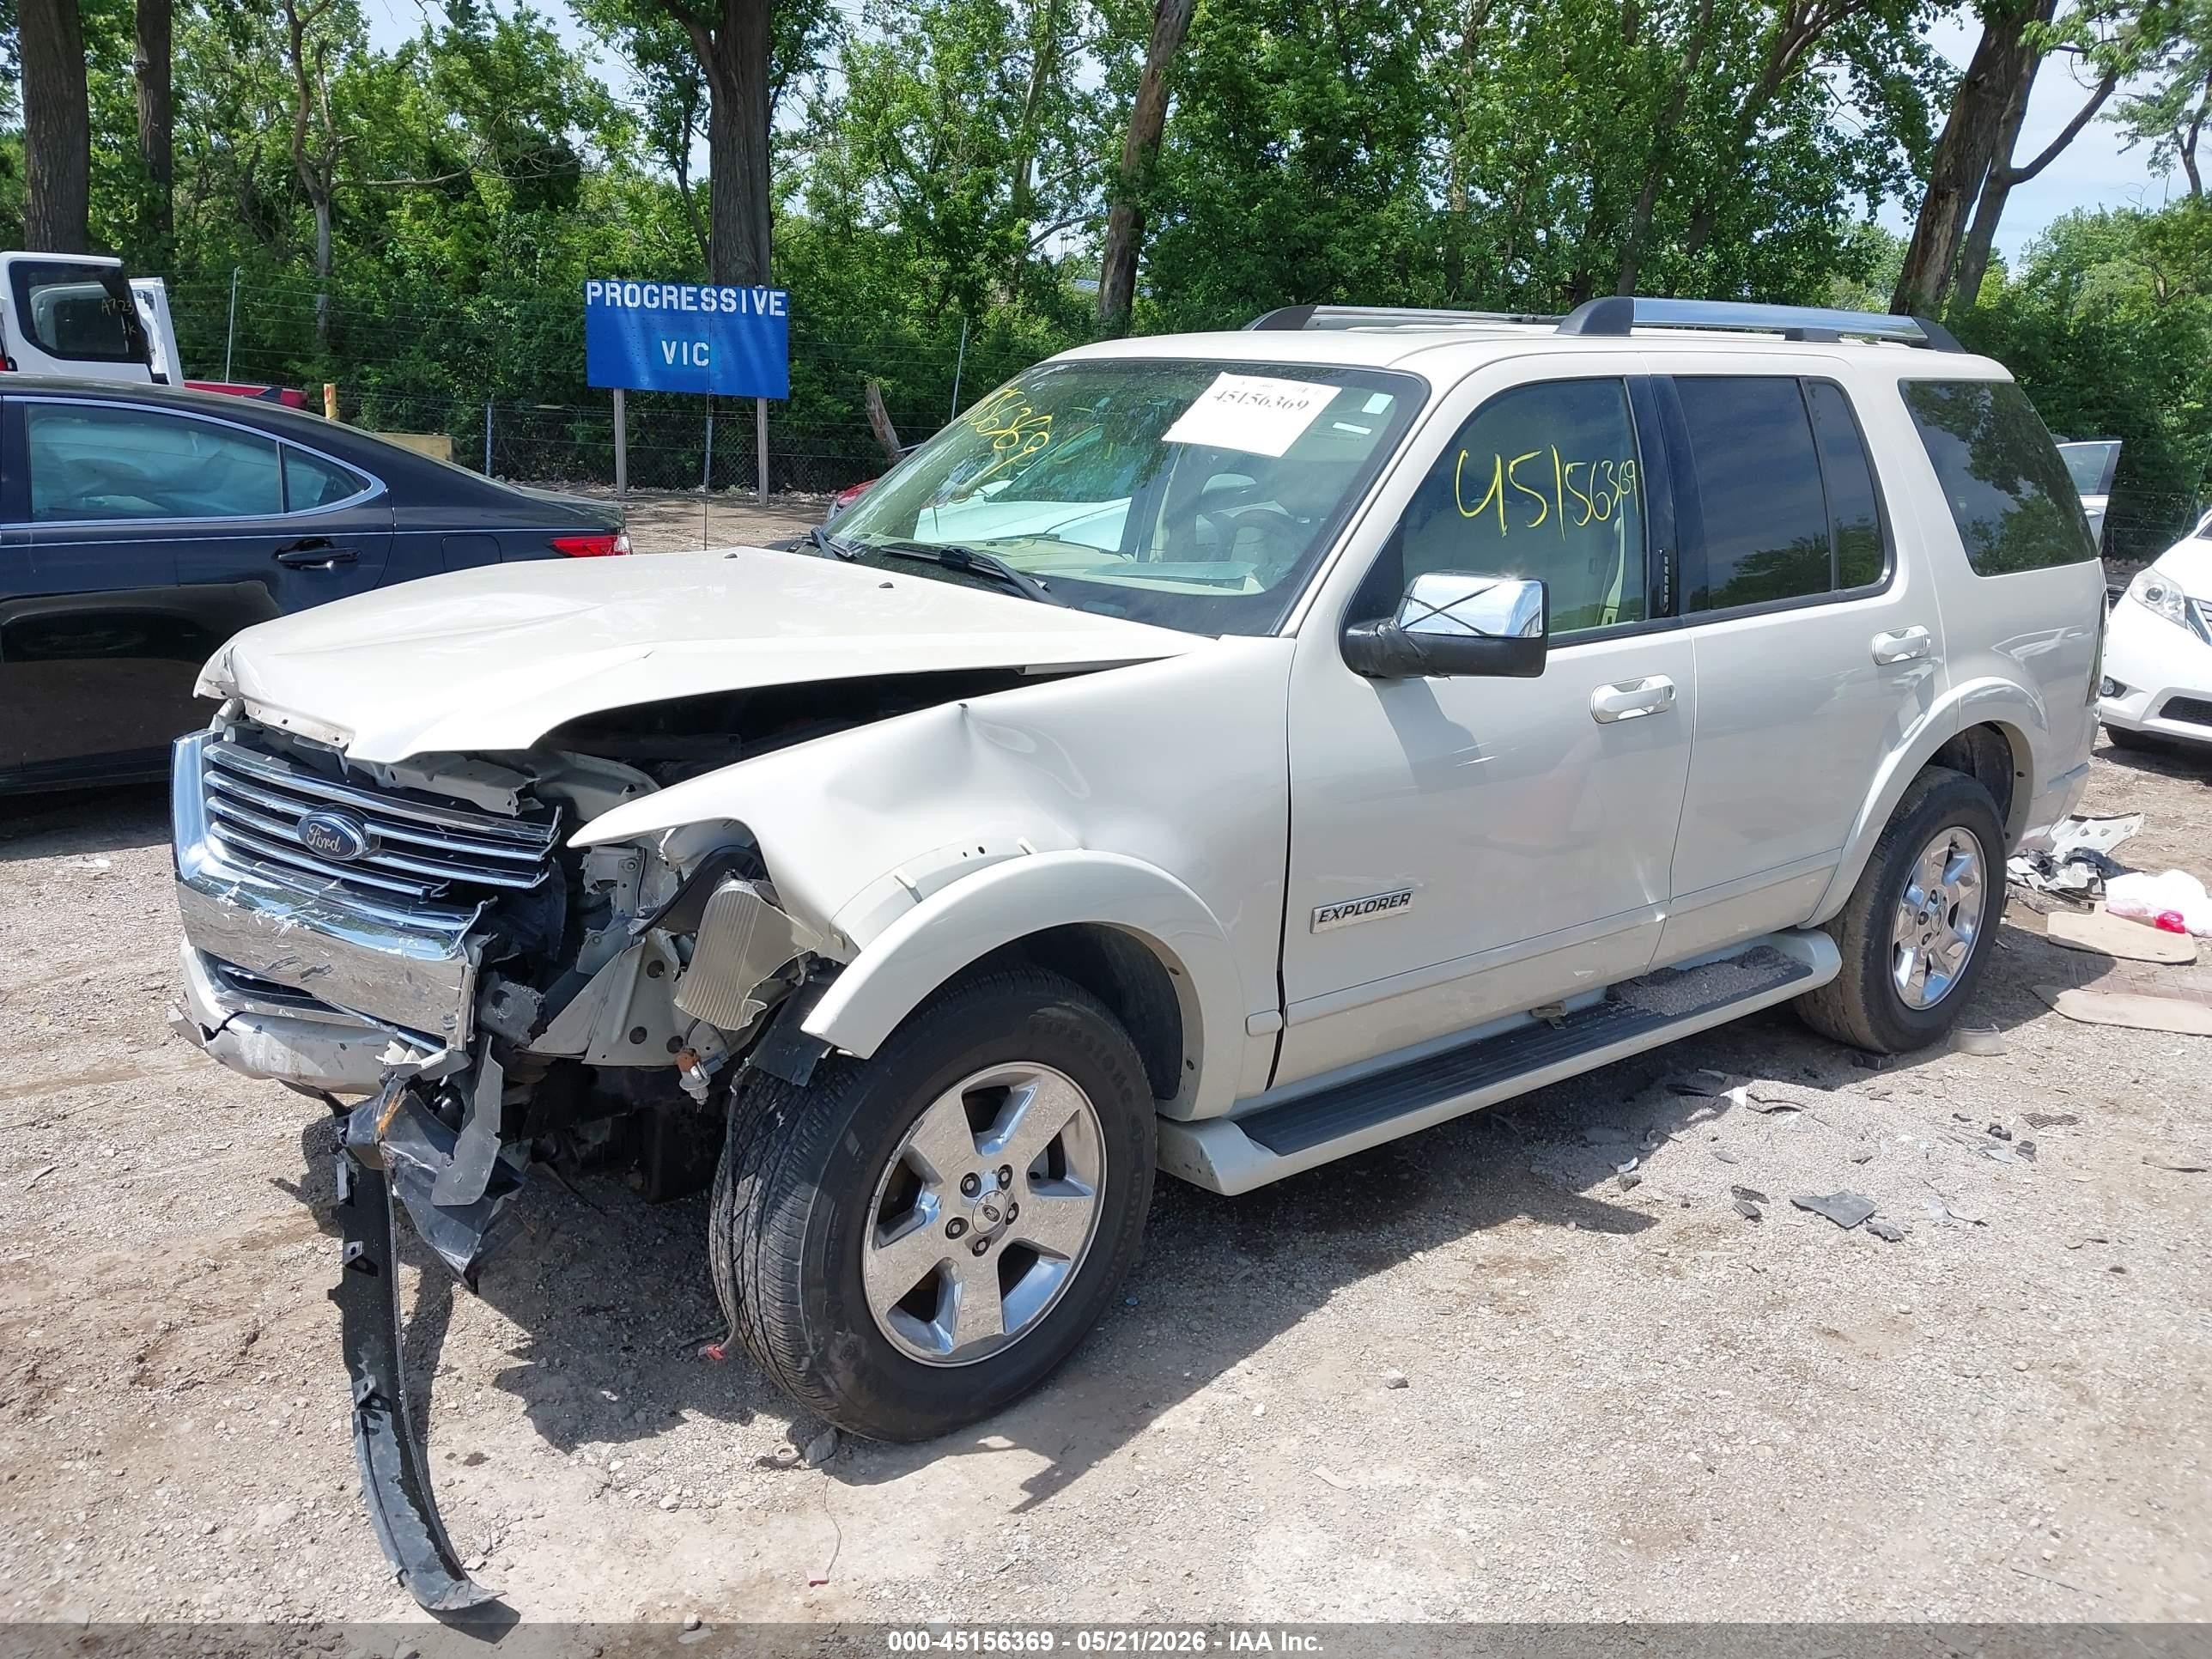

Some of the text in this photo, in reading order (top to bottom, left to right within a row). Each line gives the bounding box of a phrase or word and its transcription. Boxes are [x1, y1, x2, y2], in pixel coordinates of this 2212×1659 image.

[586, 281, 787, 316] PROGRESSIVE
[661, 340, 709, 367] VIC
[306, 822, 342, 853] Ford
[1318, 892, 1412, 923] EXPLORER
